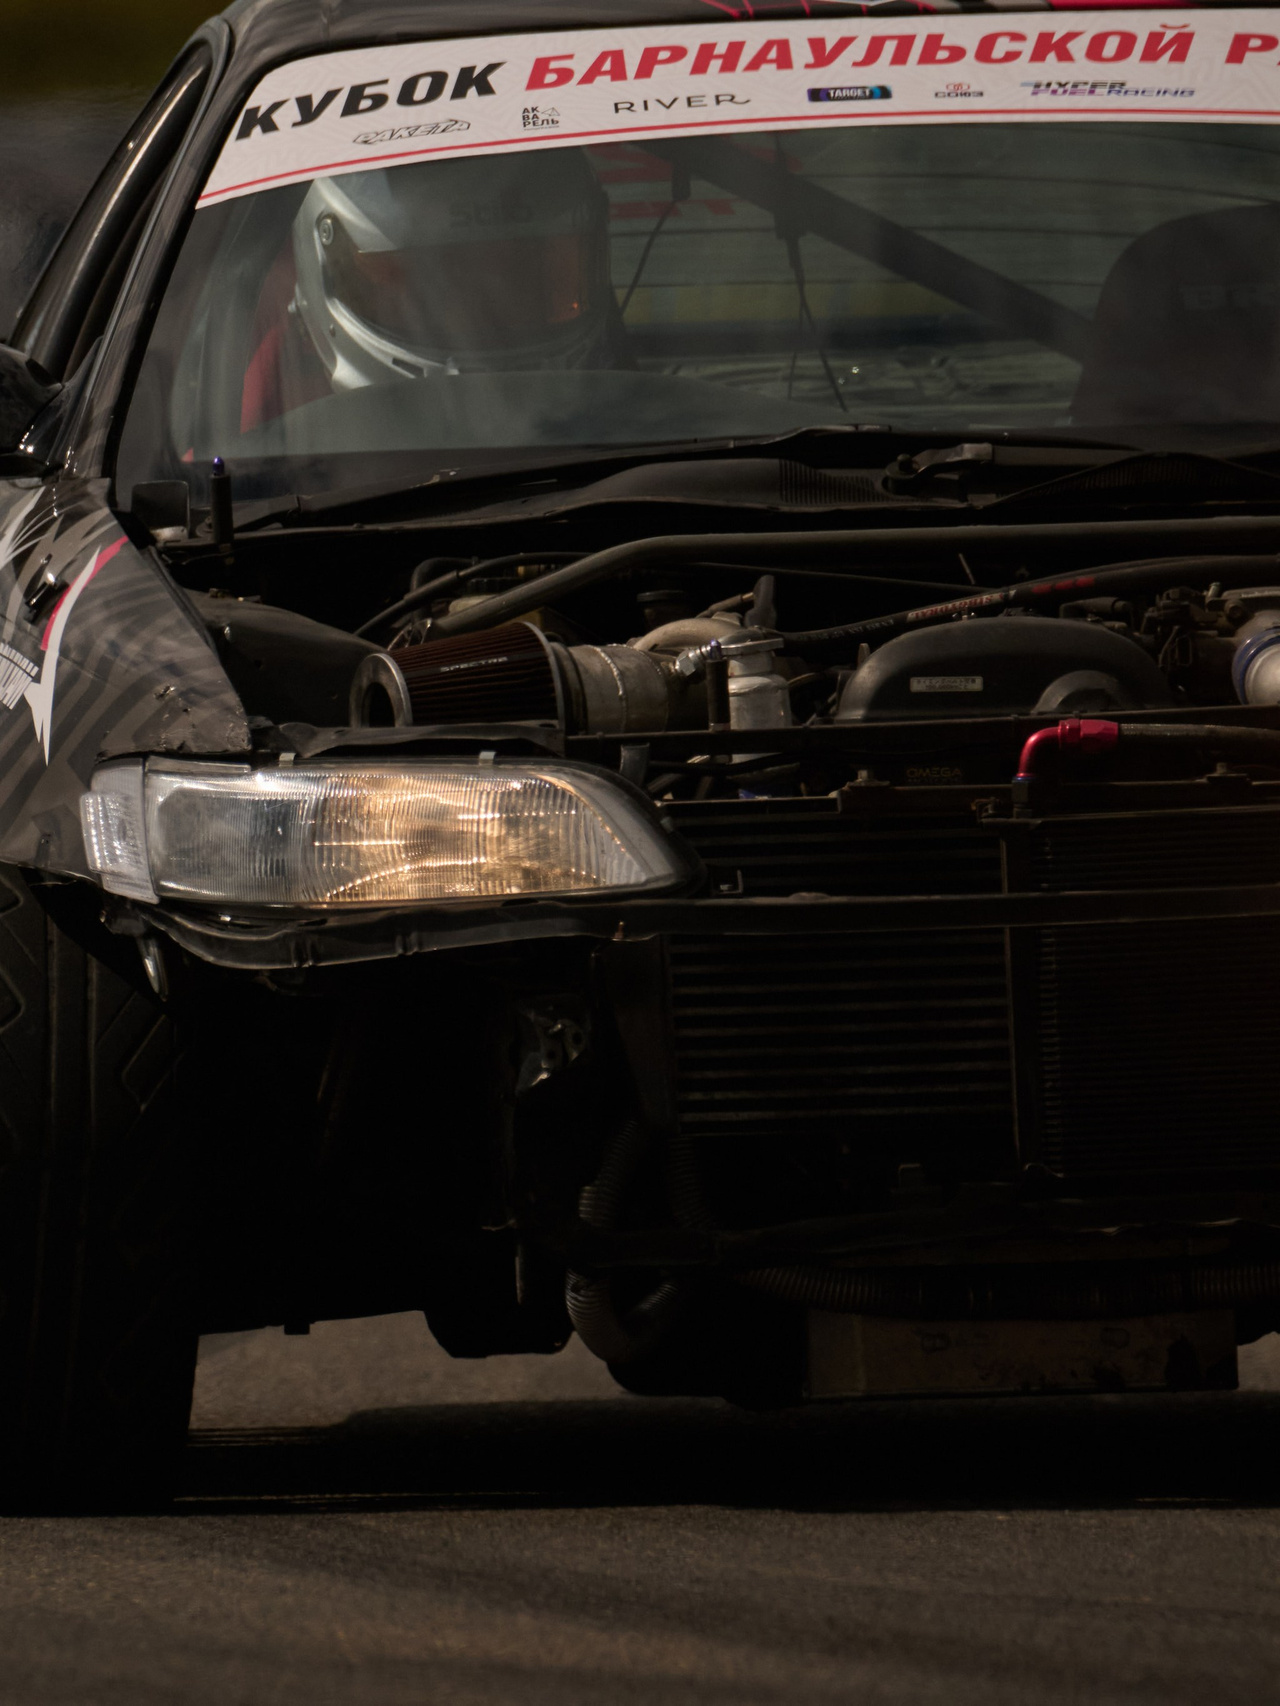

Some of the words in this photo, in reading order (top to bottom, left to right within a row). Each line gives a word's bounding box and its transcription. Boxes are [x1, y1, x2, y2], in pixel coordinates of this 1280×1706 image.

[235, 61, 508, 141] КУБОК
[525, 24, 1196, 92] БАРНАУЛЬСКОЙ
[1225, 33, 1280, 65] Р
[613, 93, 752, 114] RIVER
[828, 88, 871, 100] TARGET
